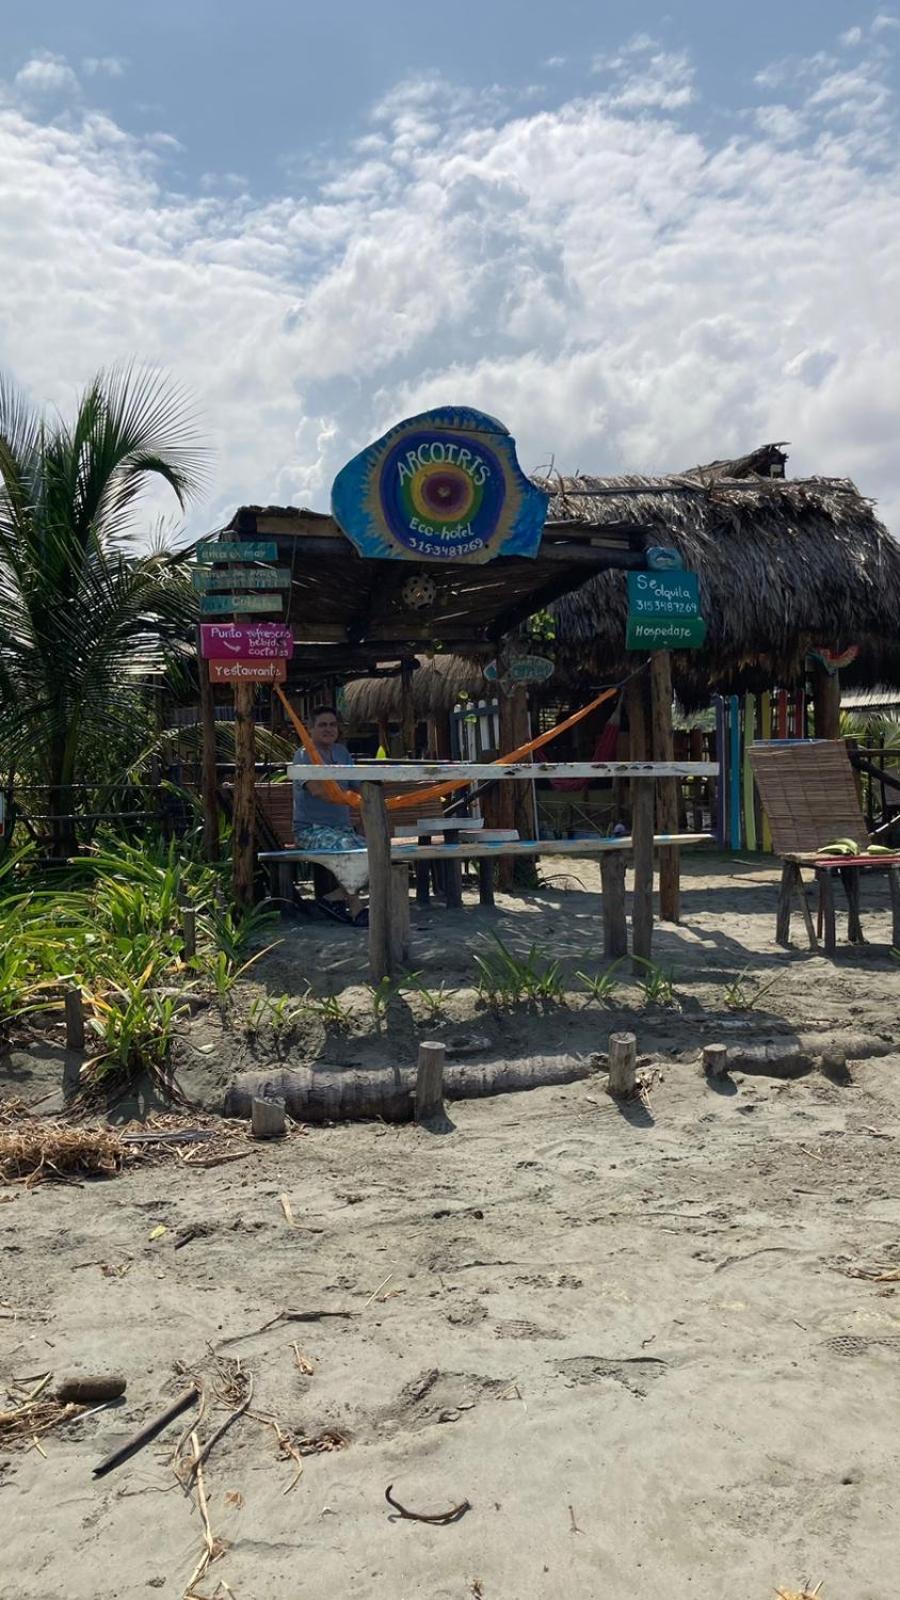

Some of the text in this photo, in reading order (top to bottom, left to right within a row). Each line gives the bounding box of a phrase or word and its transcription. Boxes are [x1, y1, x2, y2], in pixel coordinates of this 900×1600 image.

[397, 442, 491, 486] ARCOIRIS
[409, 517, 474, 540] Eco-hotel
[637, 574, 657, 590] Se
[211, 627, 242, 638] Punto
[635, 625, 692, 640] Hospedaje
